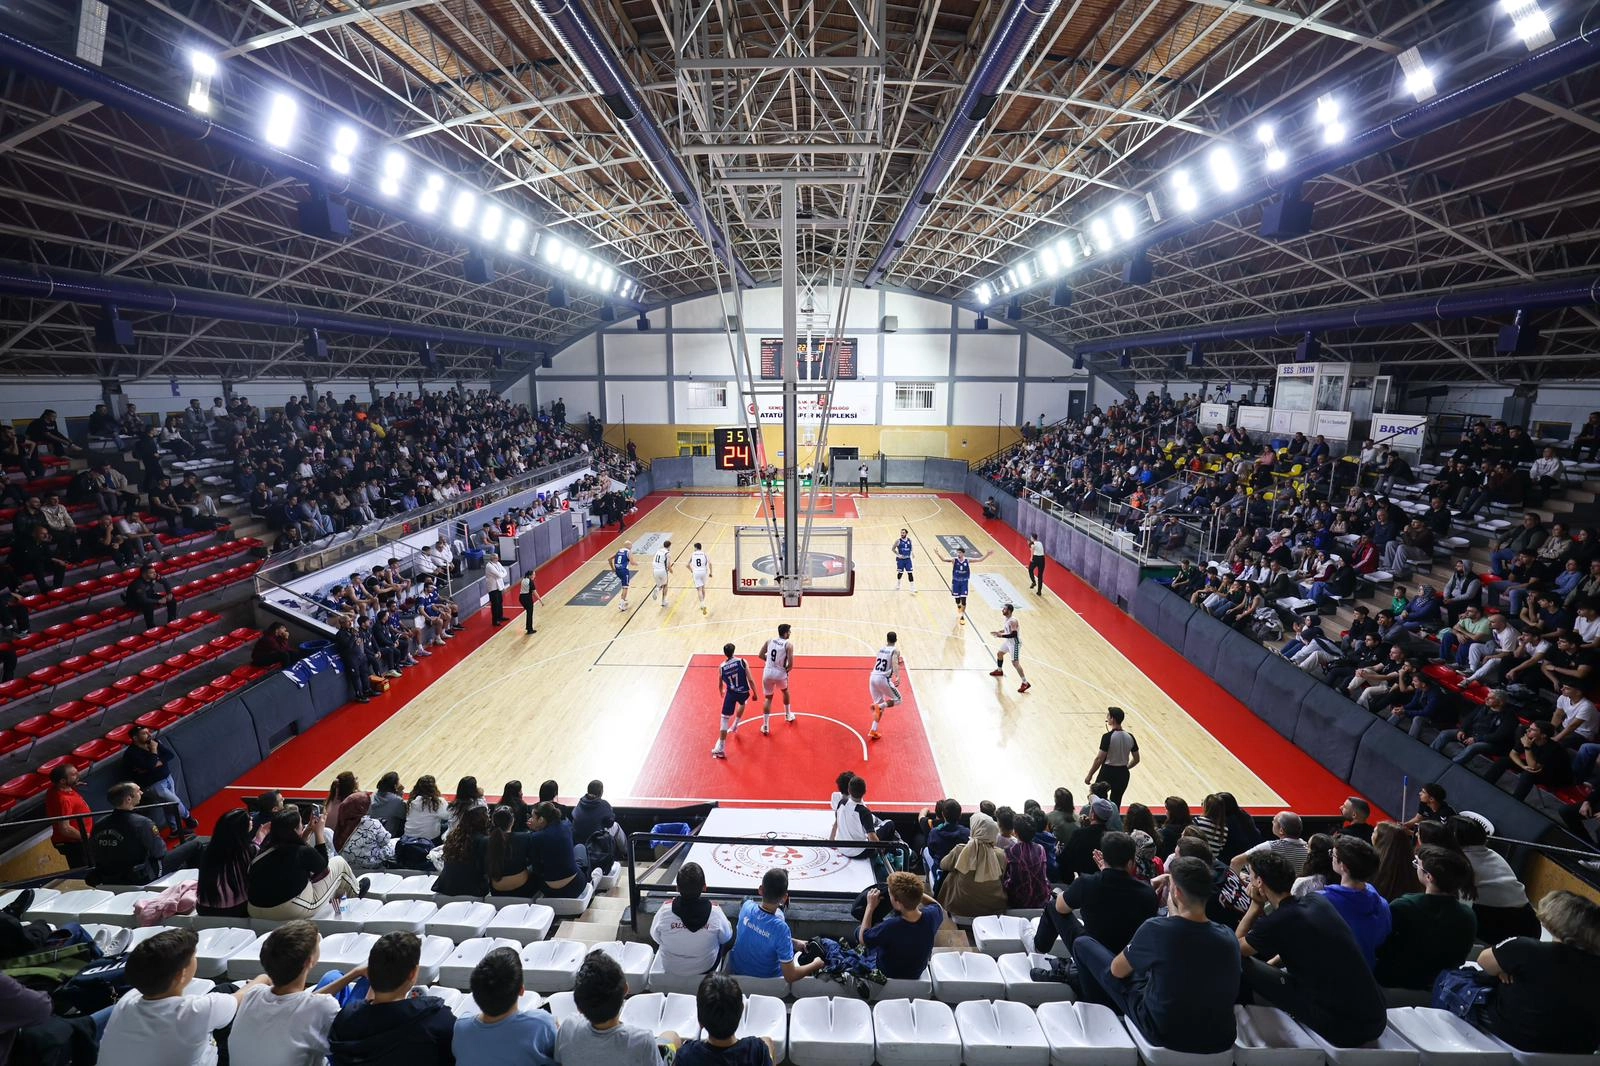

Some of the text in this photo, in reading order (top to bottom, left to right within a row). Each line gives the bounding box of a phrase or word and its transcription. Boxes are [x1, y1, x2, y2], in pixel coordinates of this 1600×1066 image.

[1283, 366, 1294, 374] SES
[1379, 424, 1419, 436] BASIN
[723, 445, 749, 467] 24
[696, 558, 702, 567] 8
[770, 649, 777, 662] 9
[875, 658, 888, 672] 23
[727, 673, 739, 689] 17
